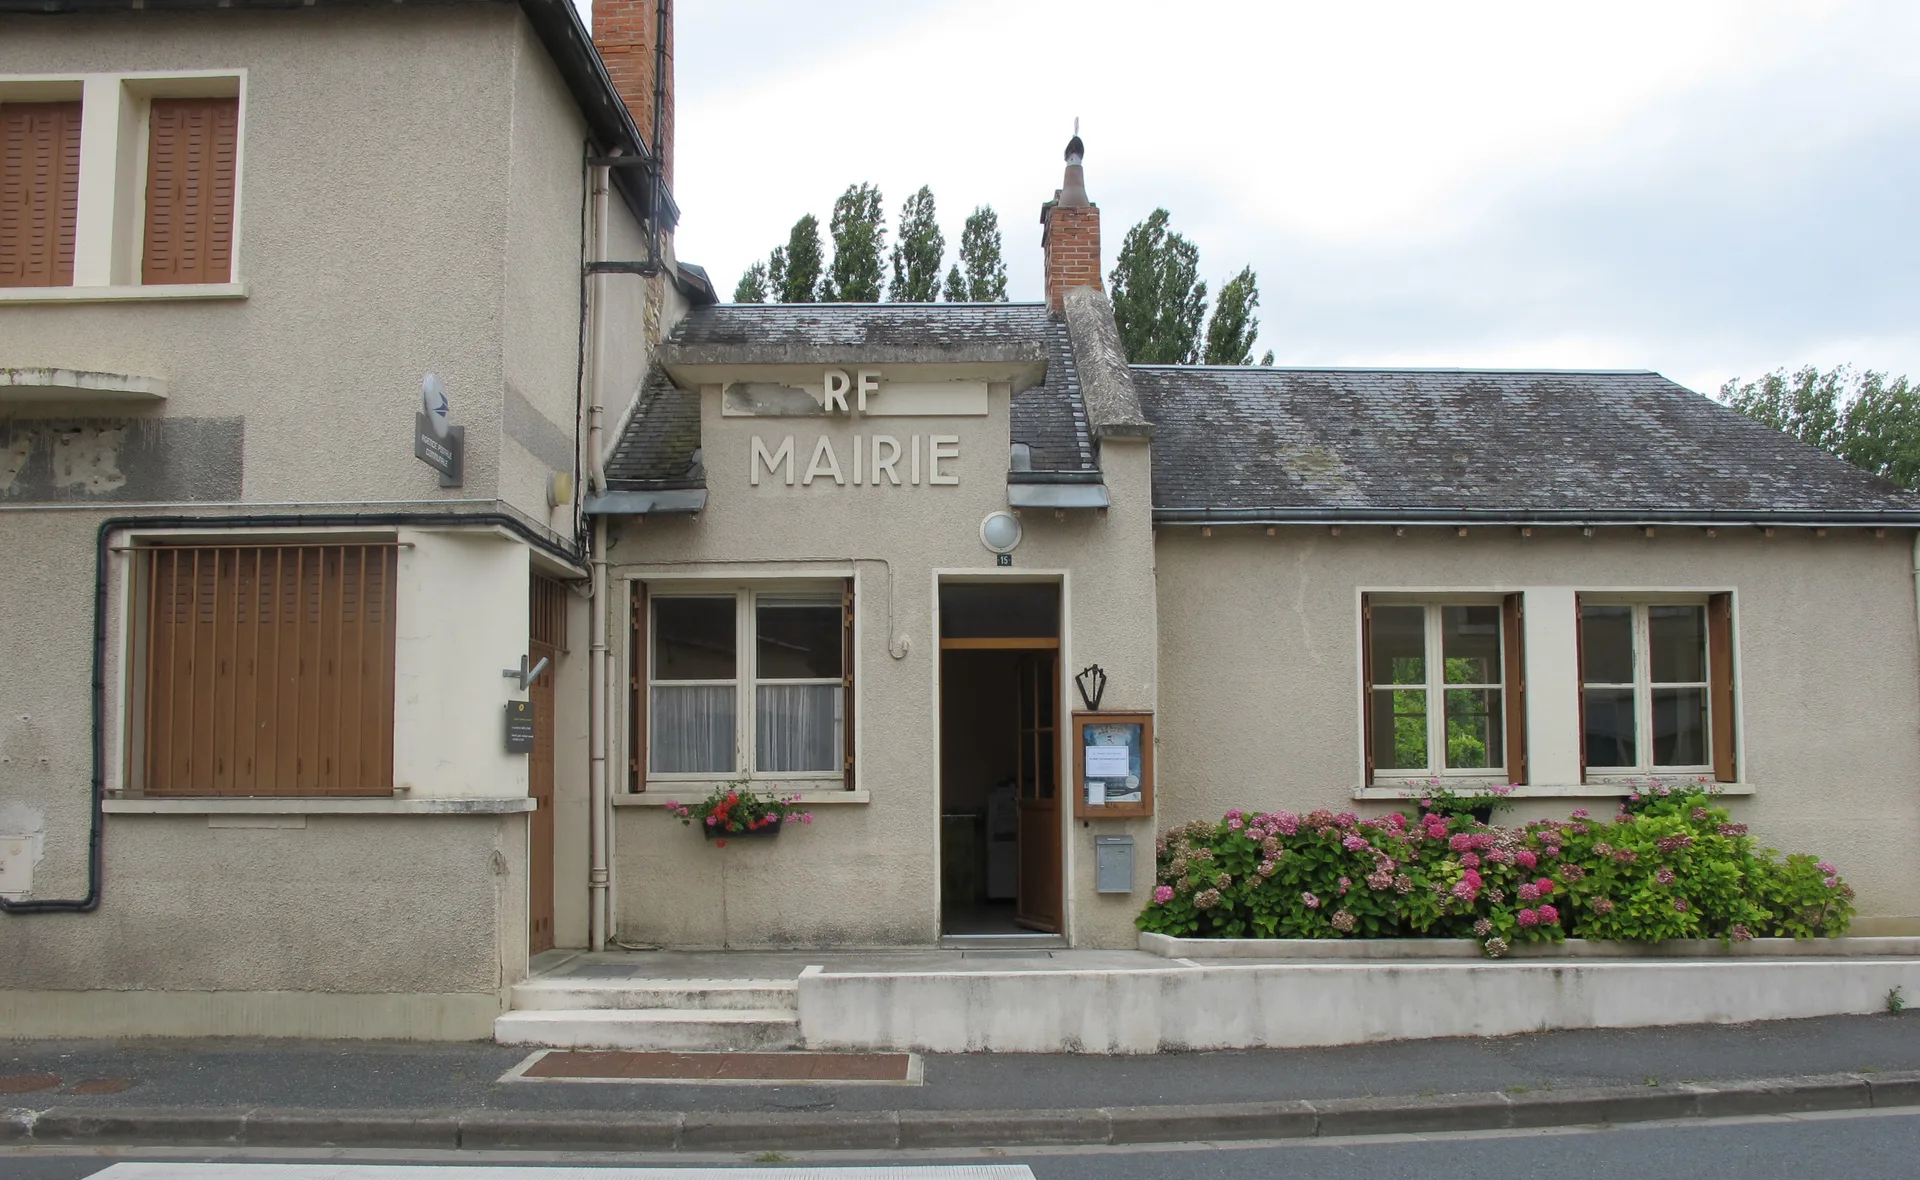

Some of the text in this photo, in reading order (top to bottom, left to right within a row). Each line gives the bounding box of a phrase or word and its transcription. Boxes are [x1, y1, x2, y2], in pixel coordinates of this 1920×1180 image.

[824, 369, 882, 413] RF
[750, 434, 959, 485] MAIRIE
[1000, 556, 1008, 565] 15
